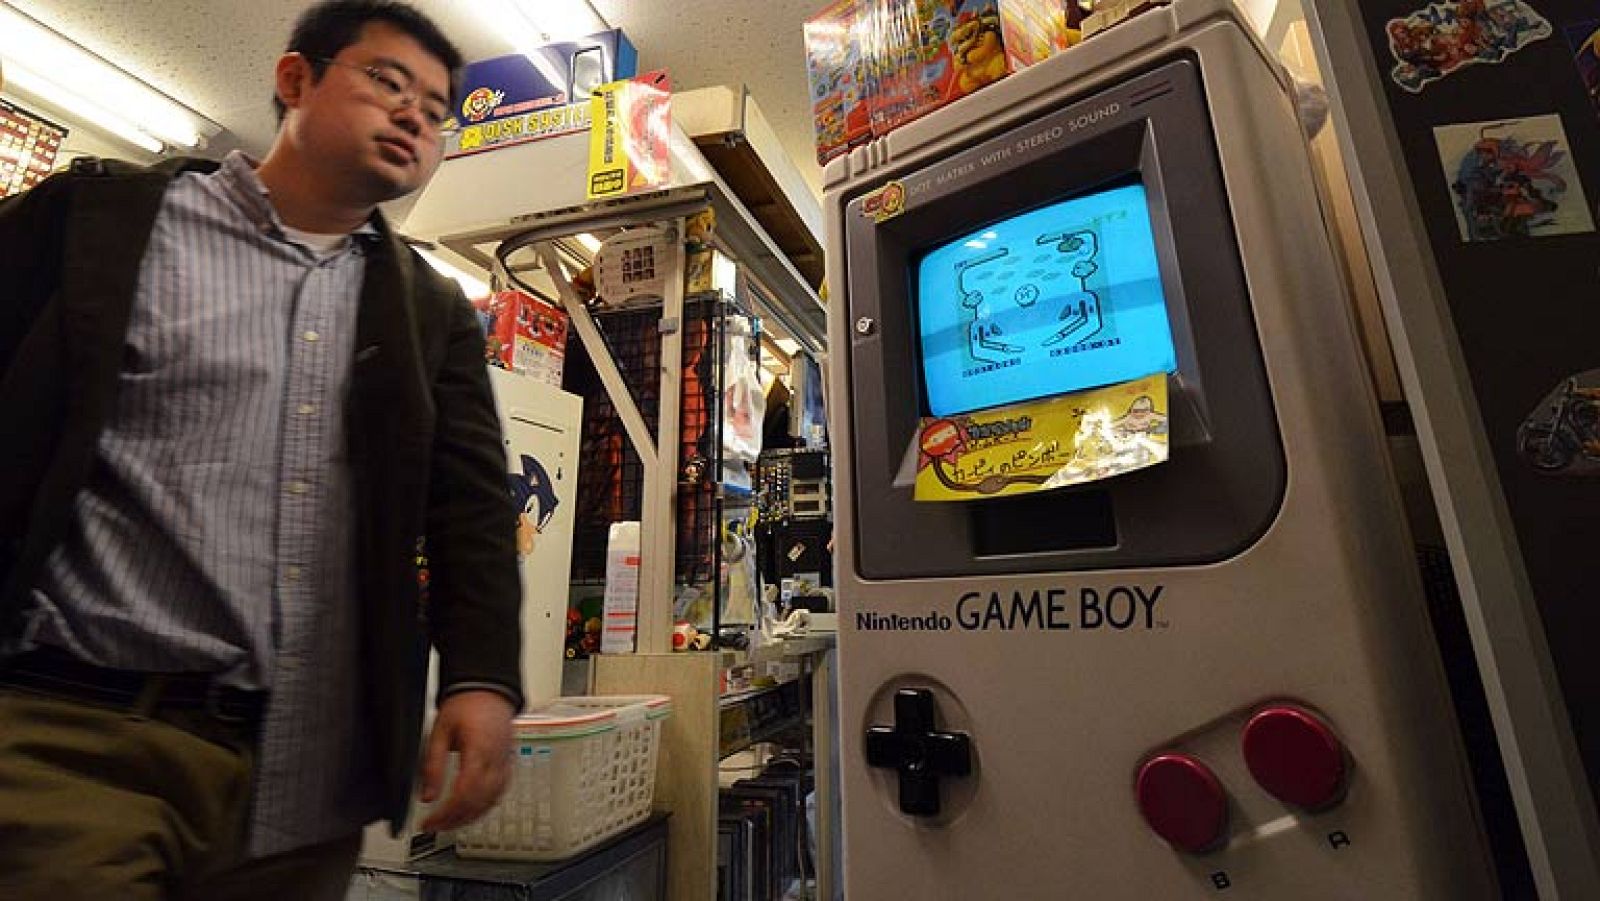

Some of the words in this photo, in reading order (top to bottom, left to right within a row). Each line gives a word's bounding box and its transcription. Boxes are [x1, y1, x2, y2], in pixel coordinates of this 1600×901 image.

[937, 163, 976, 184] MATRIX
[981, 147, 1012, 166] WITH
[1016, 126, 1063, 153] STEREO
[1068, 102, 1120, 132] SOUND
[856, 611, 952, 630] Nintendo
[956, 591, 1070, 629] GAME
[1080, 586, 1164, 629] BOY
[1328, 831, 1350, 850] A
[1212, 871, 1231, 890] B
